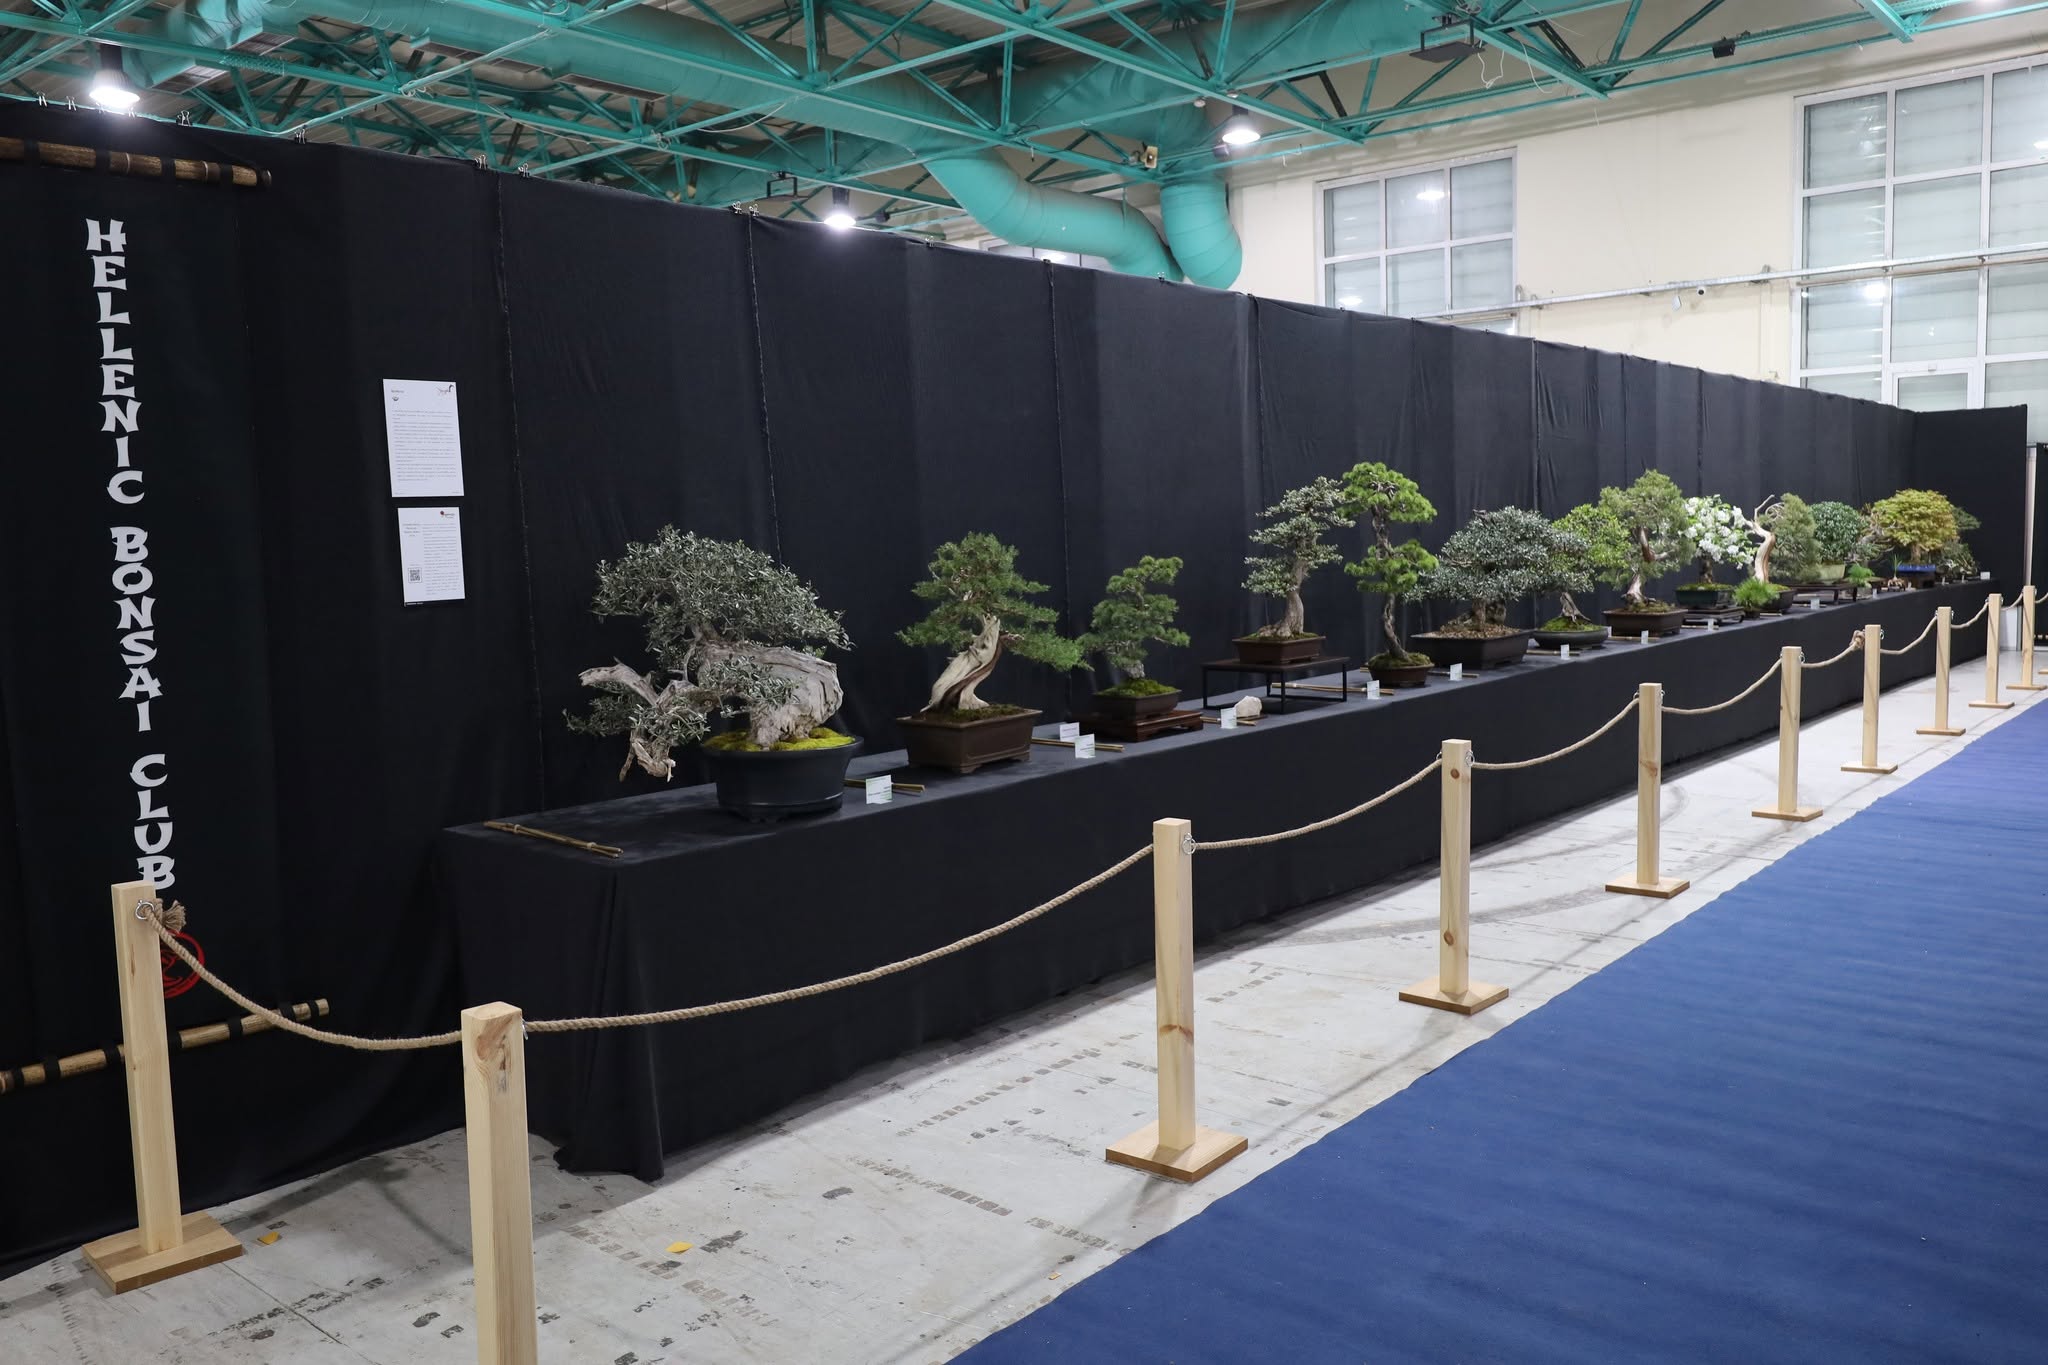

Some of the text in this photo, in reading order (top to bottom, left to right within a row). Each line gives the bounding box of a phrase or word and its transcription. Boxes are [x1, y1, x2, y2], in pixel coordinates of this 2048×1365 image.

[85, 218, 176, 890] HELLENIC BONSAI CLUB
